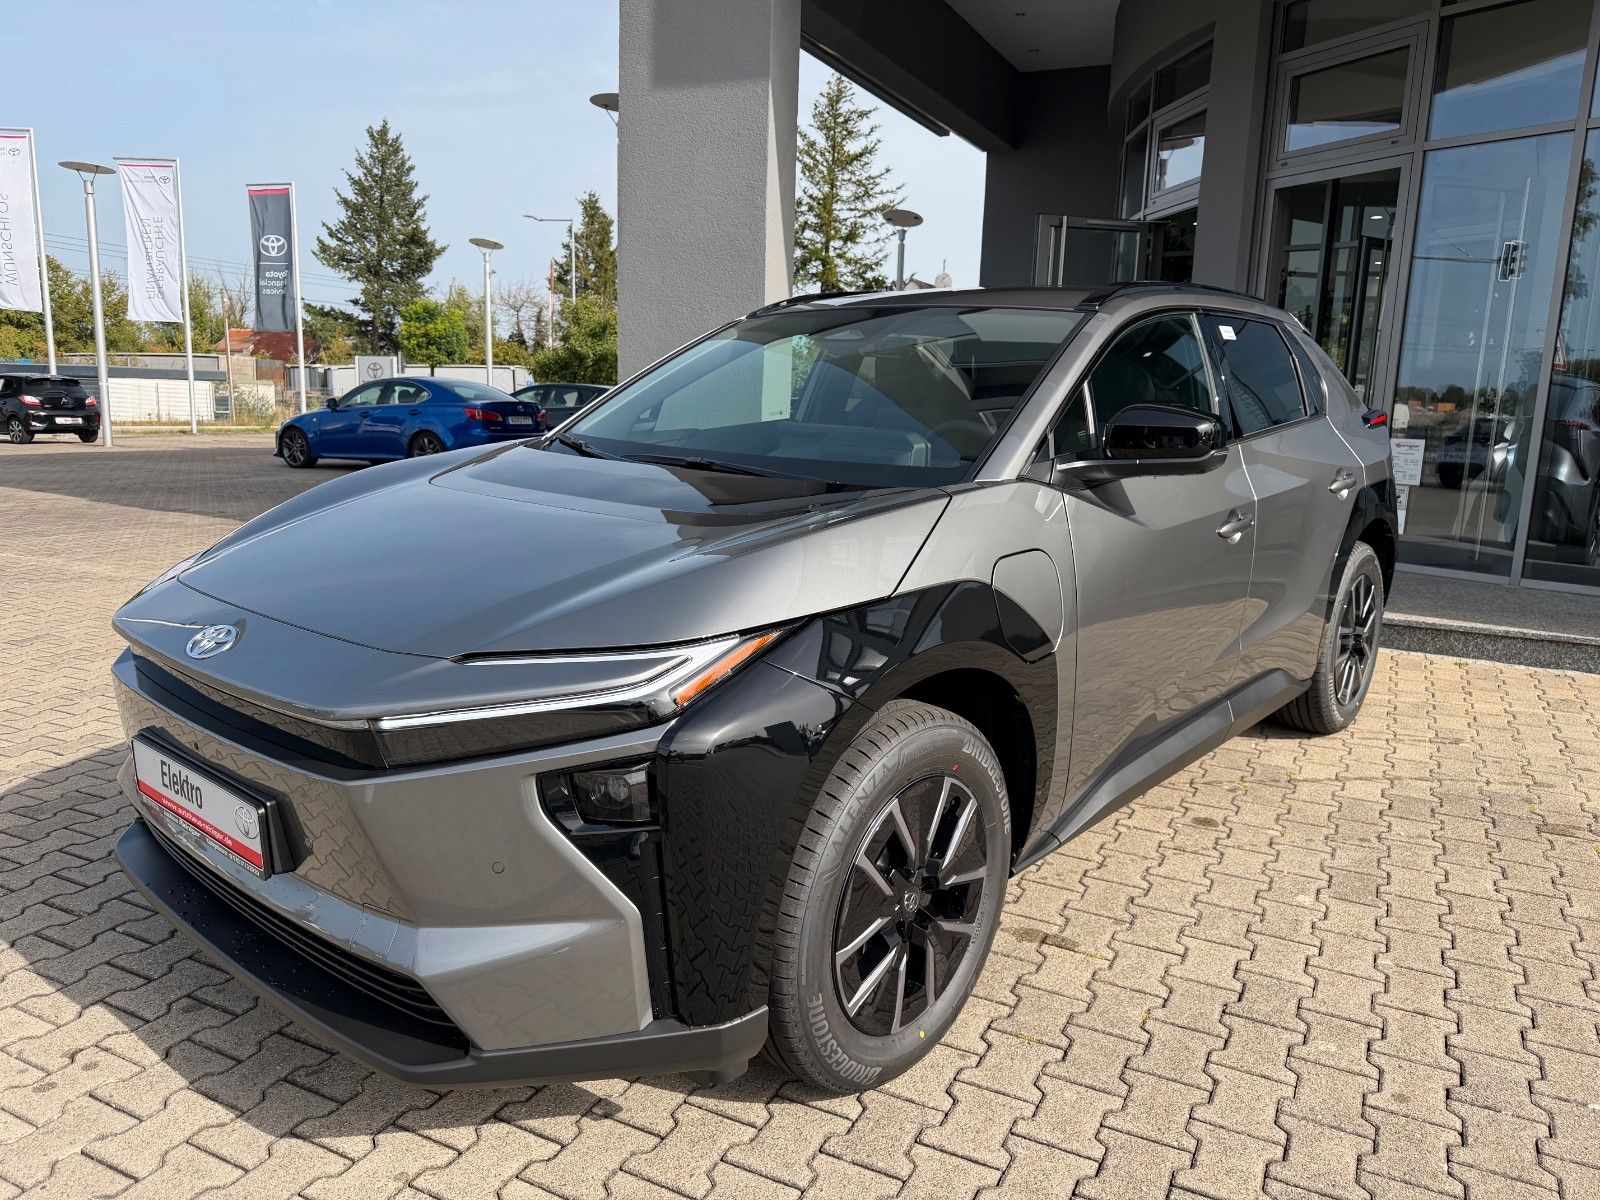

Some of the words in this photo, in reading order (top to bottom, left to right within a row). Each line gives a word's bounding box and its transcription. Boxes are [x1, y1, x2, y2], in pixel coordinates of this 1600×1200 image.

[160, 760, 203, 809] Elektro
[831, 762, 898, 854] ALENZA
[962, 737, 1011, 835] BRIDGESTONE
[807, 993, 883, 1085] BRIDGESTONE
